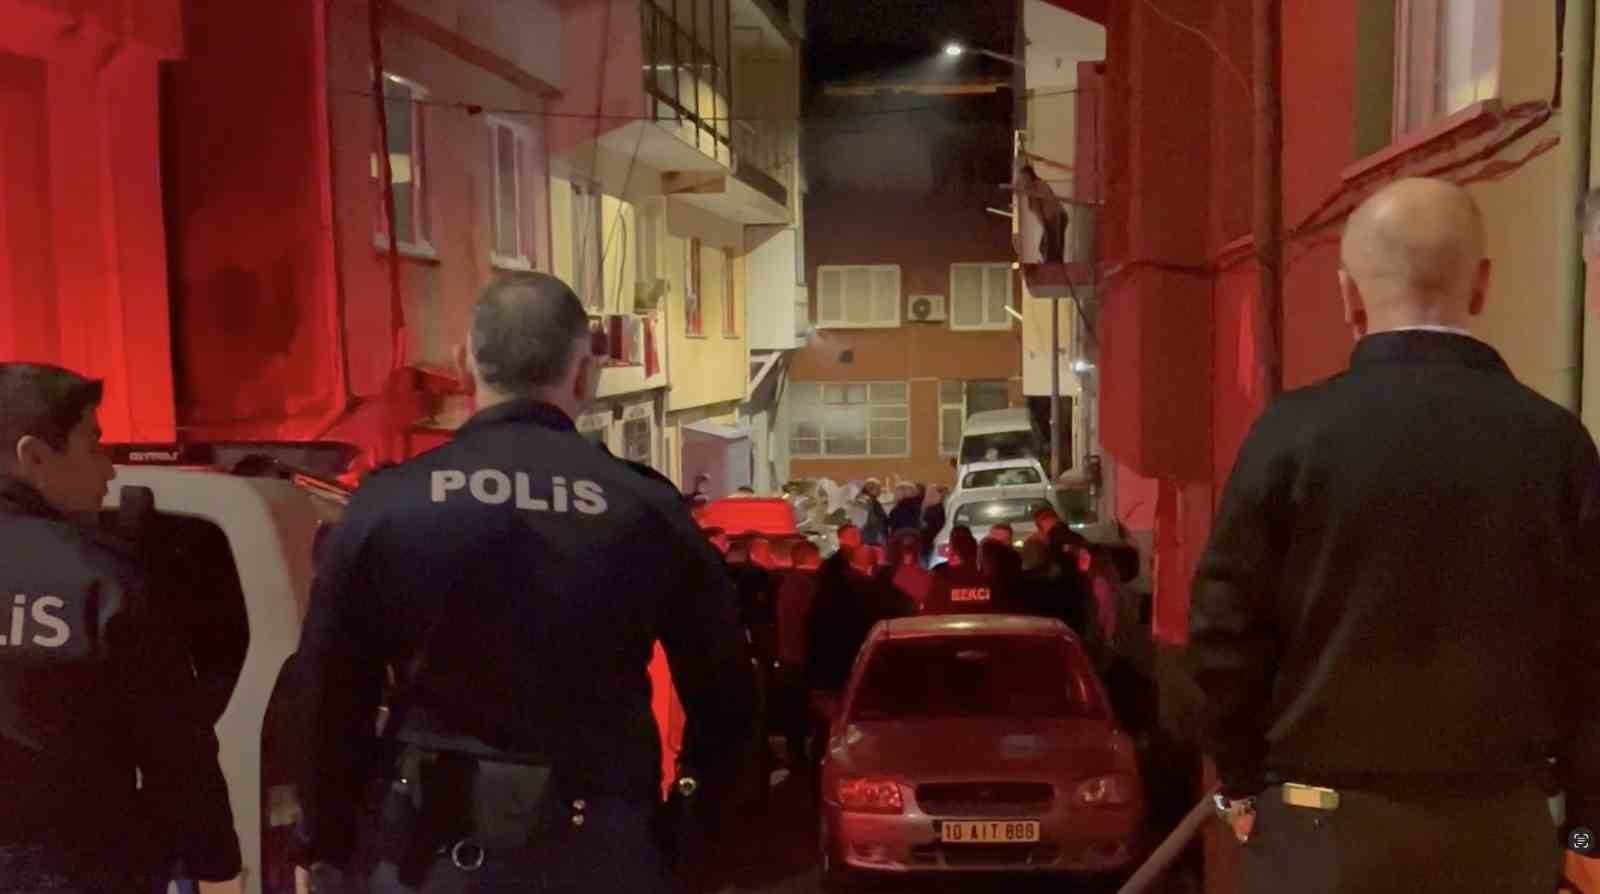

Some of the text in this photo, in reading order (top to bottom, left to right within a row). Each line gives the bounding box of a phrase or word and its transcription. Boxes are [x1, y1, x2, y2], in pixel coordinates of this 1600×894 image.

[0, 594, 70, 647] iS
[945, 824, 962, 840] 10
[970, 824, 998, 840] AIT
